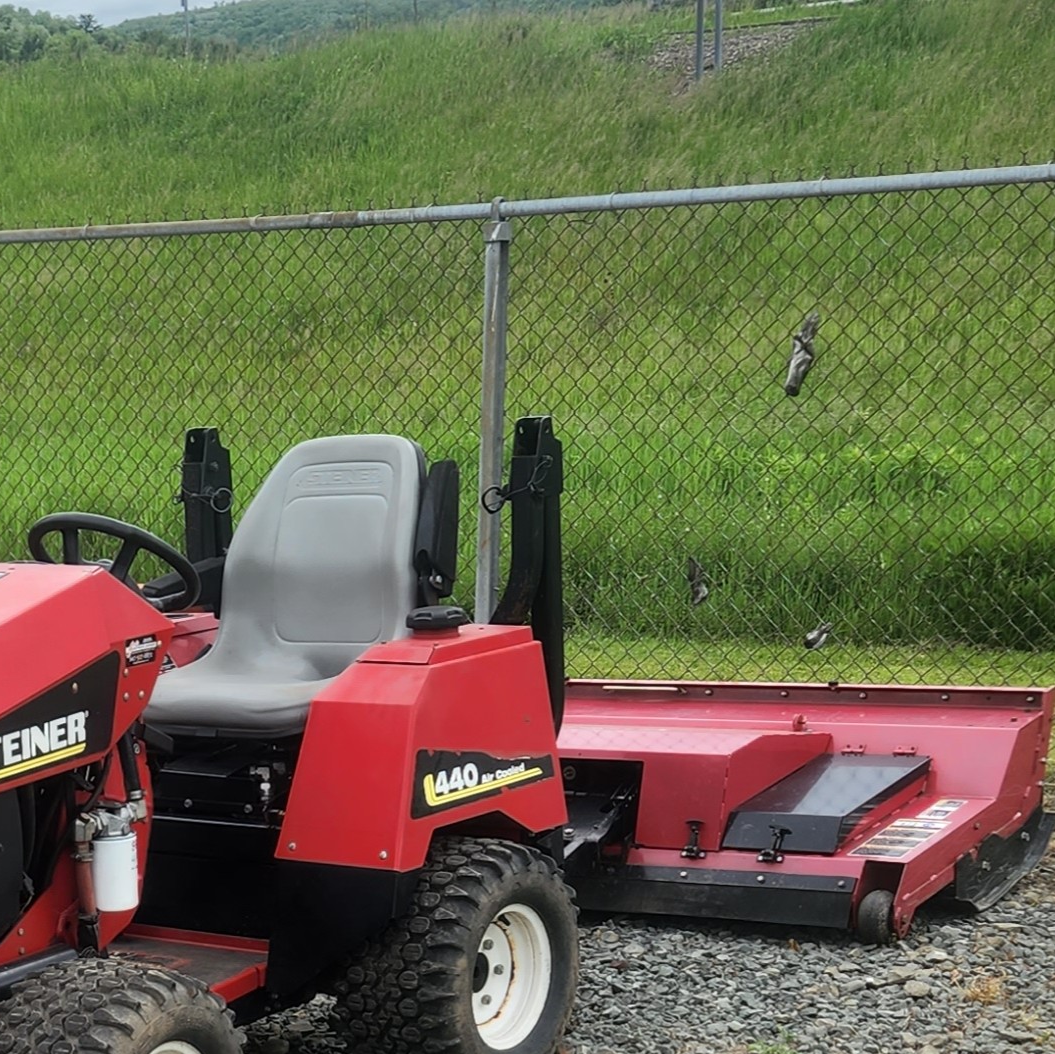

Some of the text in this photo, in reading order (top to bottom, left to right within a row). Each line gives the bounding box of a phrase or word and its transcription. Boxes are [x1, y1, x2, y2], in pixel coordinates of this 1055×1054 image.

[435, 762, 525, 794] 440 Air Cooled
